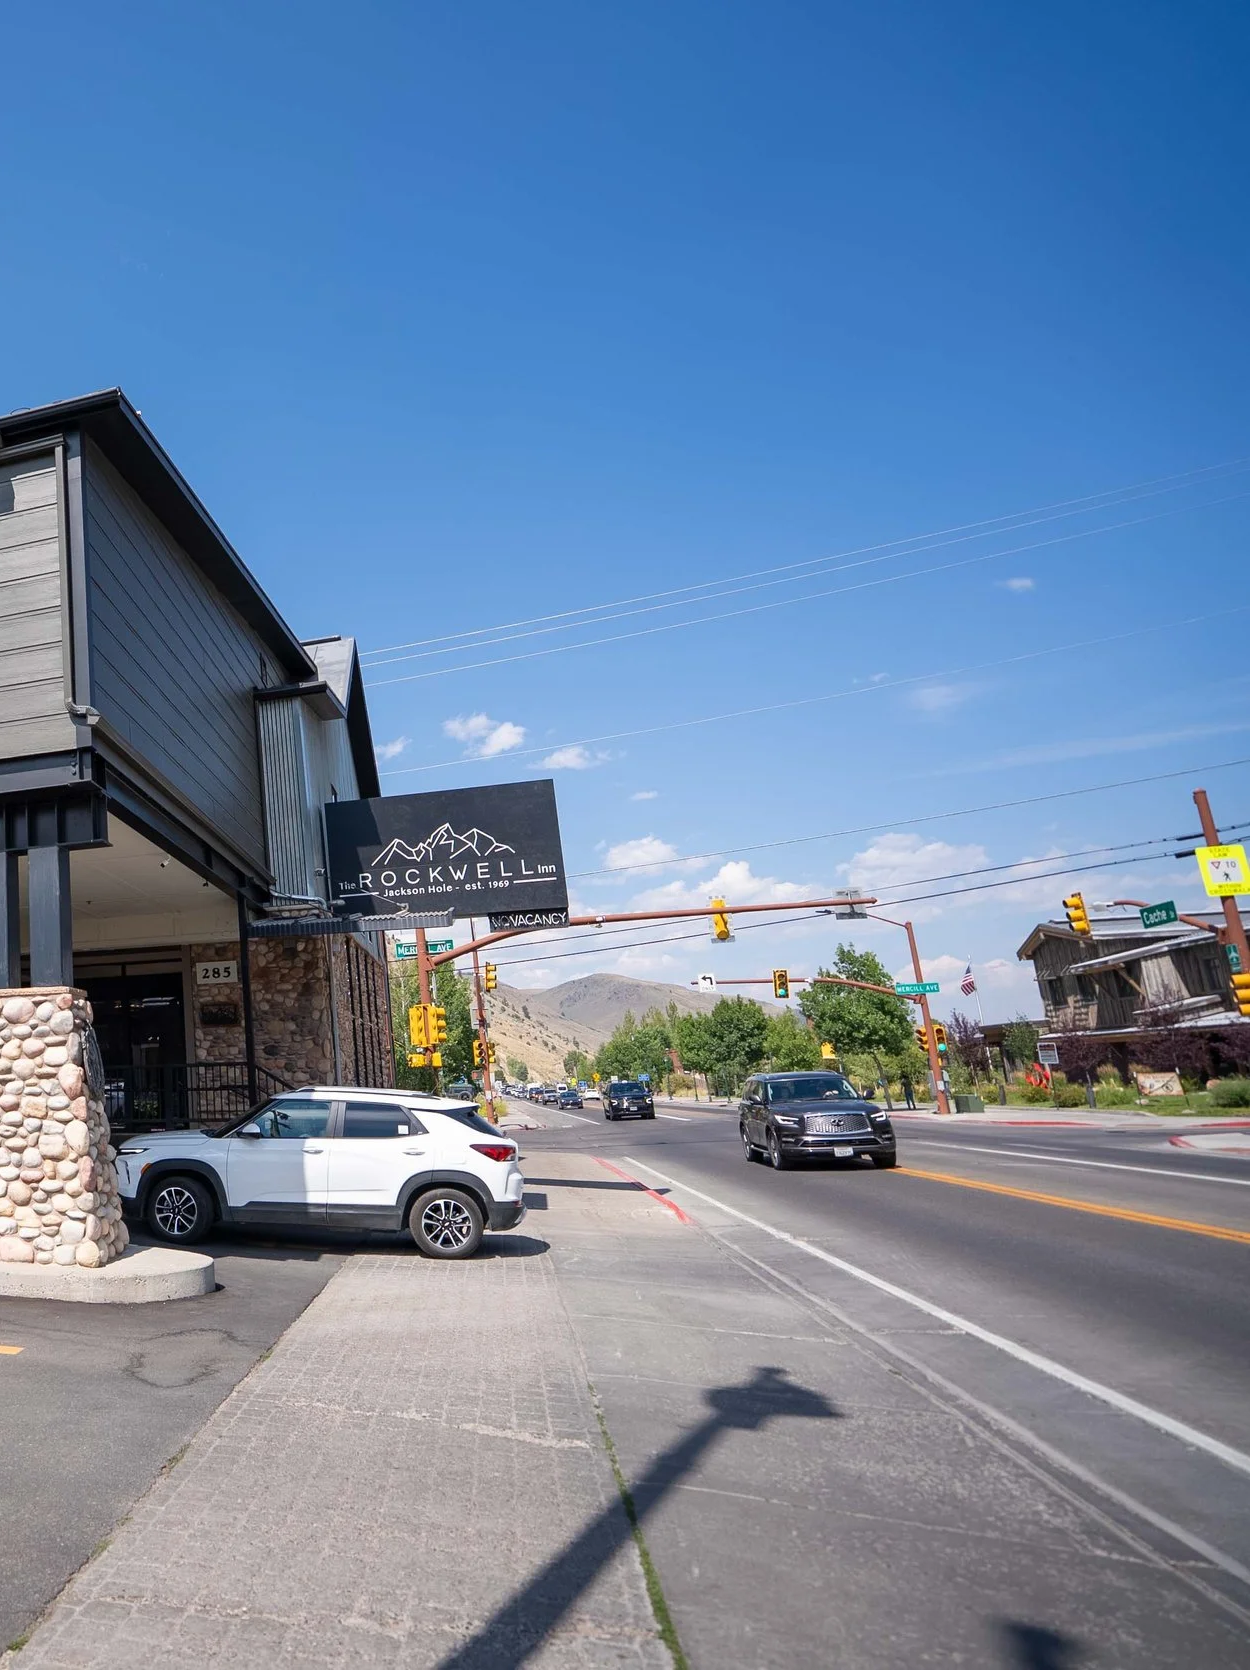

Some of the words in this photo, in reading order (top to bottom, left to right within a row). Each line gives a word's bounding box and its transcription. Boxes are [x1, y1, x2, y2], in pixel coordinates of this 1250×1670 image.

[338, 881, 356, 891] The
[358, 859, 534, 888] ROCKWELL
[537, 864, 556, 874] Inn
[383, 887, 425, 897] Jackson
[428, 884, 453, 895] Hole
[465, 881, 485, 891] est.
[488, 880, 510, 889] 1969
[510, 912, 567, 928] VACANCY
[1143, 909, 1167, 925] Cache
[436, 942, 452, 953] AVE
[202, 966, 231, 979] 285
